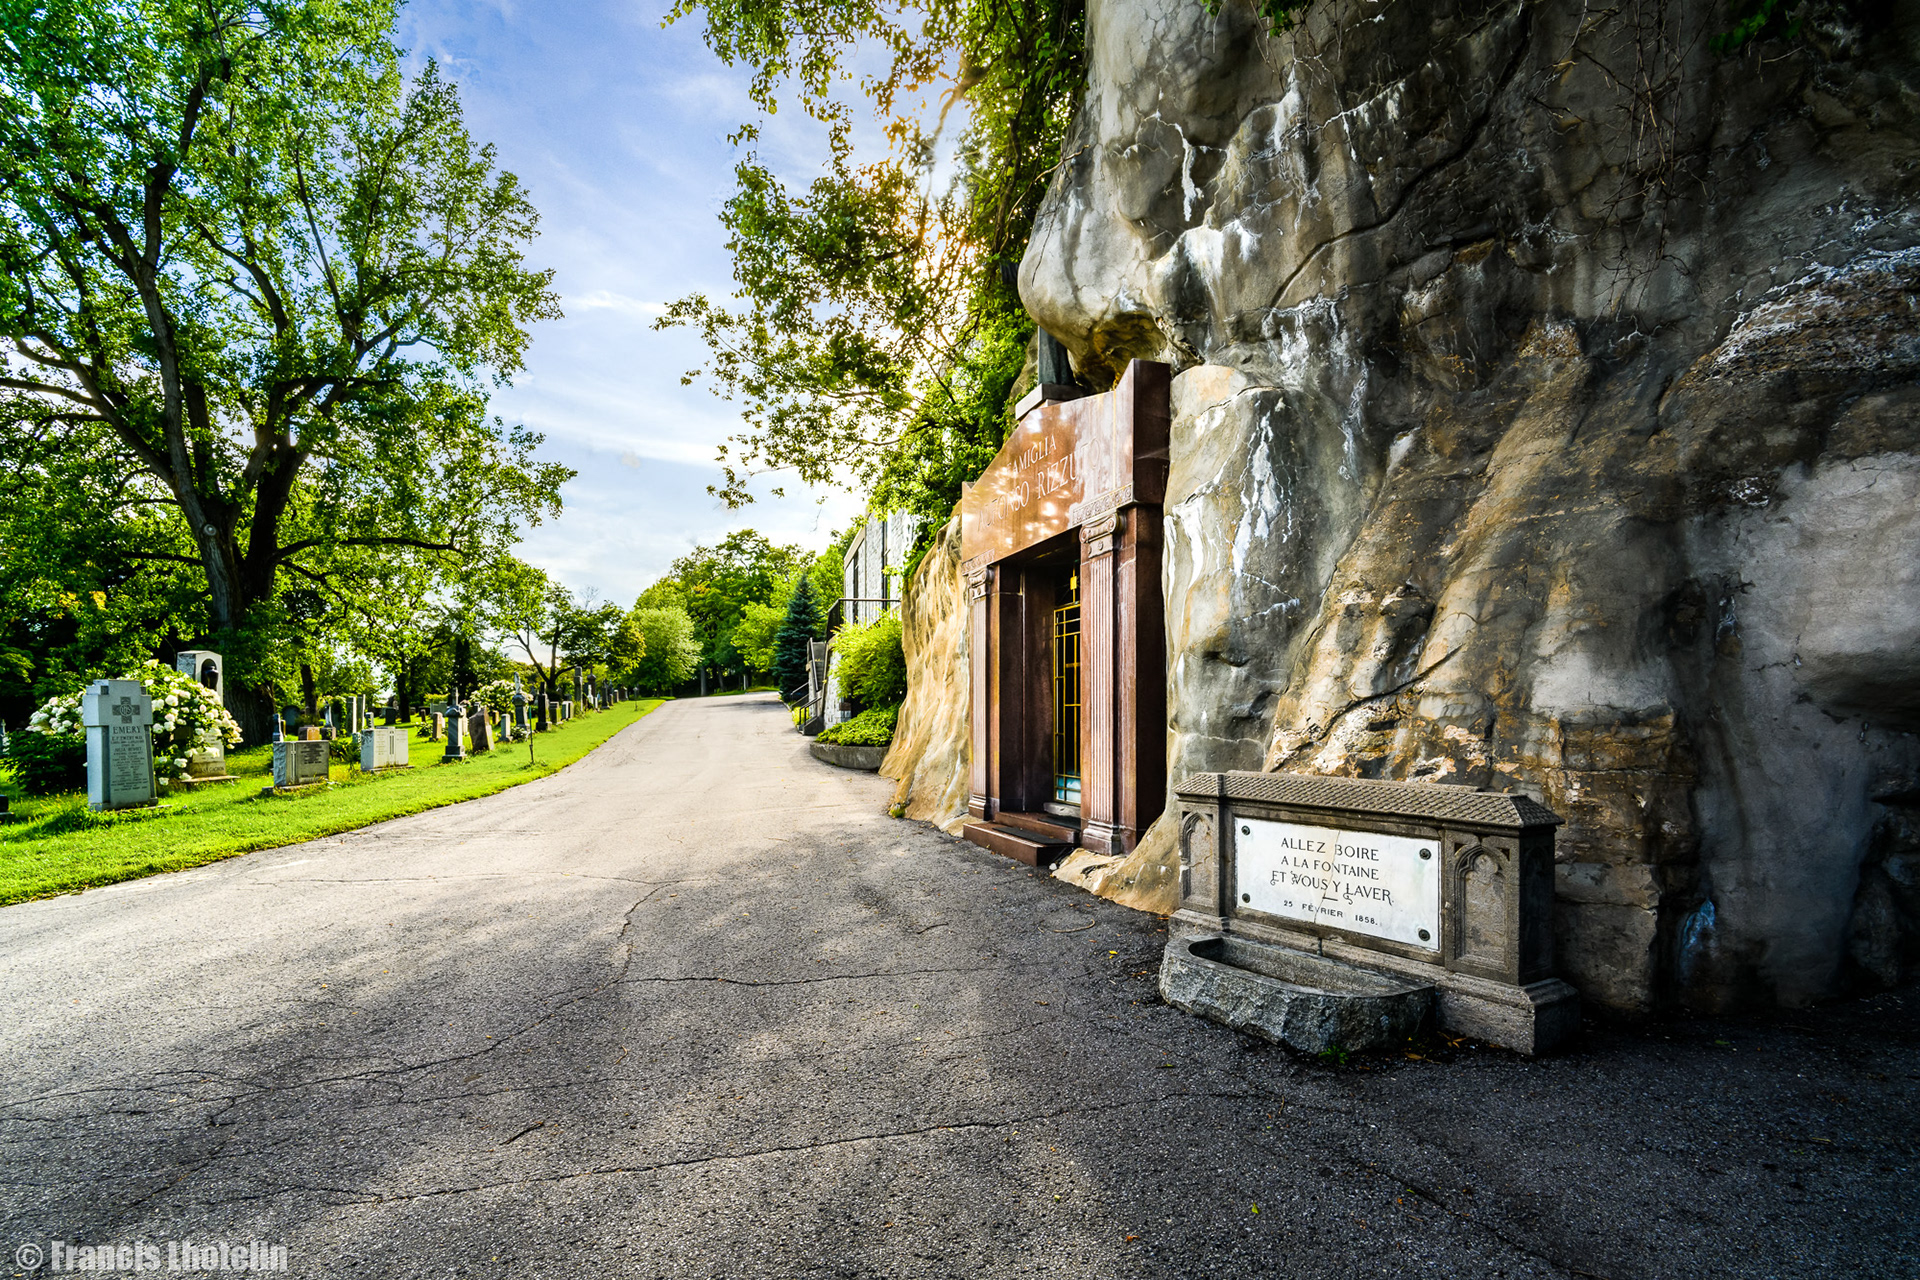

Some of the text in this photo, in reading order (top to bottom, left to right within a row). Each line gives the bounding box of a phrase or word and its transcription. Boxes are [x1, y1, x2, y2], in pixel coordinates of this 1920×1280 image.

[1006, 434, 1057, 478] FAMIGLIA
[1037, 438, 1100, 500] RIZZUTO
[113, 726, 141, 734] EMERY
[1281, 837, 1379, 861] ALLEZ BOIRE
[1281, 856, 1379, 880] A LA FONTAINE
[1270, 870, 1287, 886] ET
[1290, 871, 1328, 890] VOUS
[1332, 881, 1341, 893] Y
